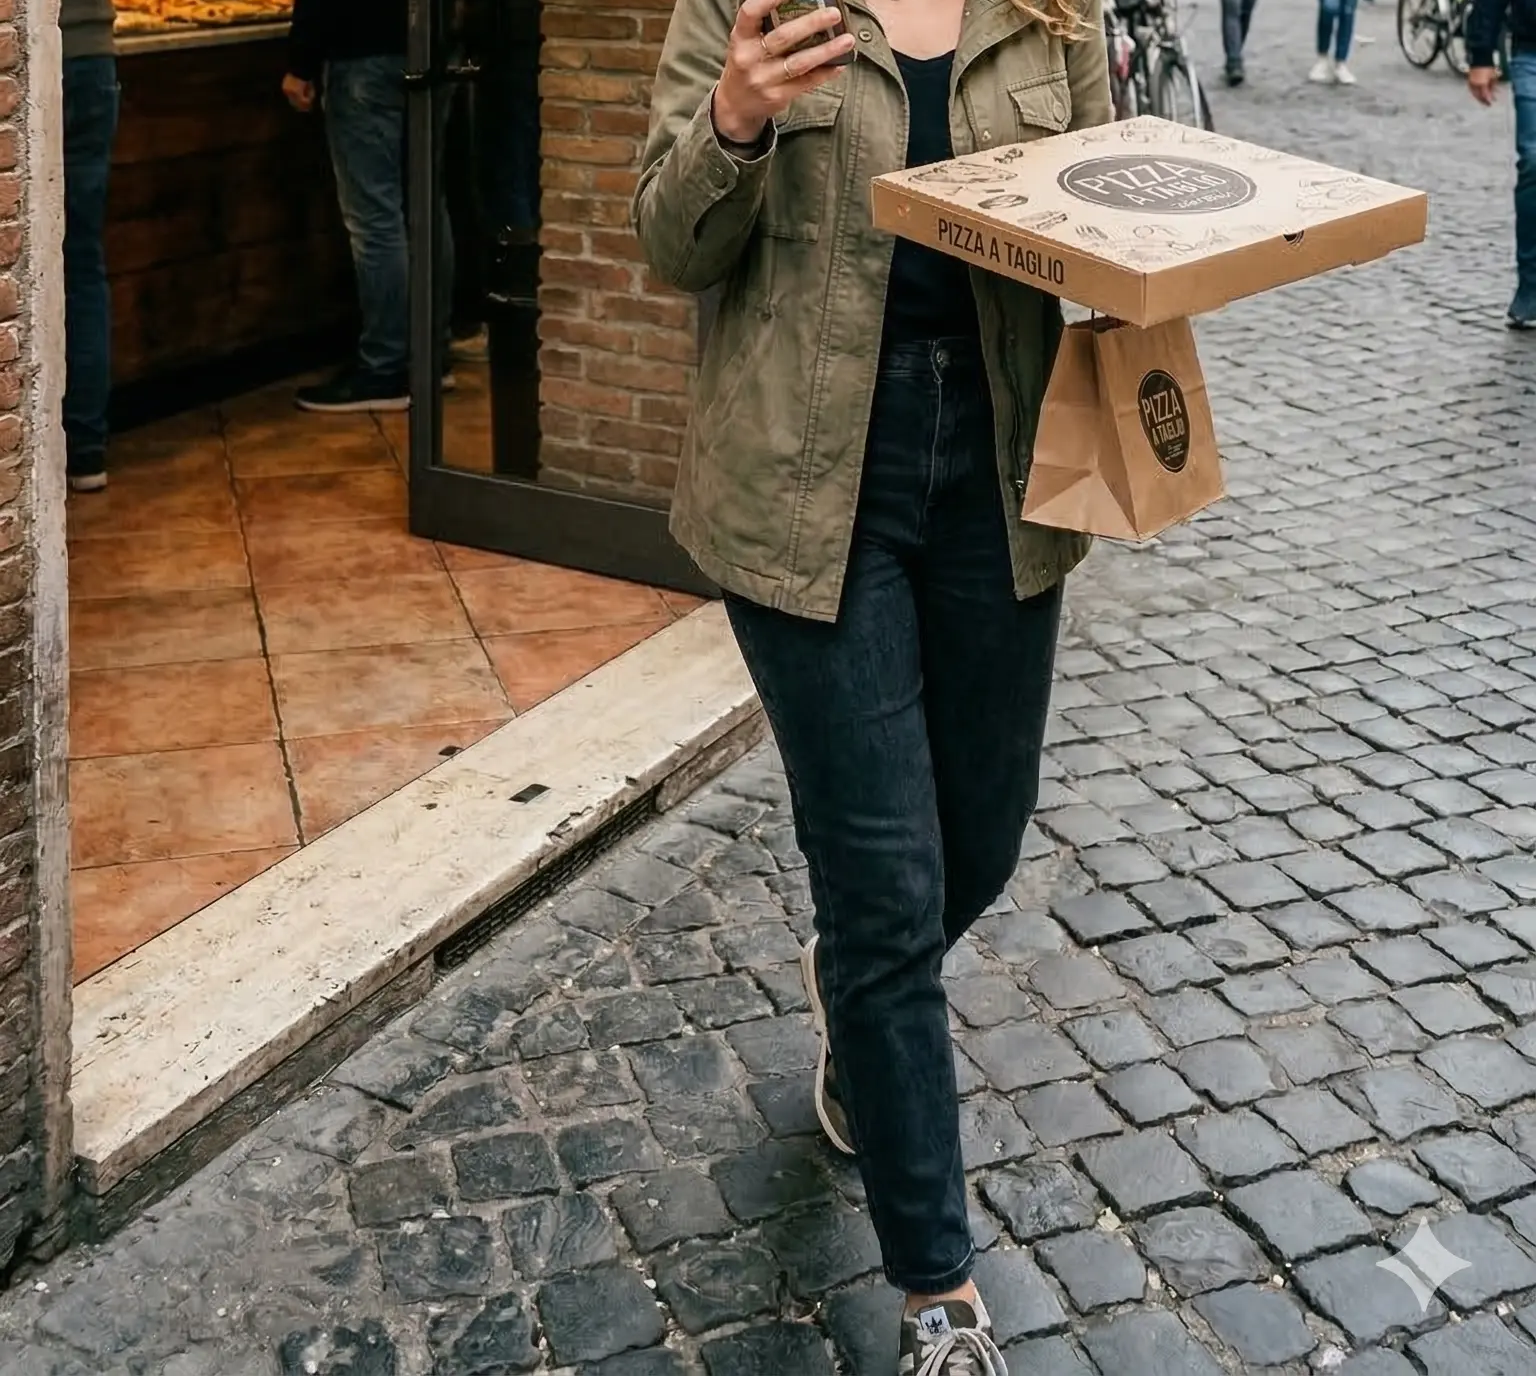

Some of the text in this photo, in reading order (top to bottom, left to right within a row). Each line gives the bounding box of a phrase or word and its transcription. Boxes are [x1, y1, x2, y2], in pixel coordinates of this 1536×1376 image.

[1073, 160, 1206, 195] PIZZA
[1122, 191, 1156, 206] A
[938, 217, 1064, 285] PIZZA A TAGLIO
[1141, 387, 1182, 428] PIZZA
[1151, 427, 1160, 446] A
